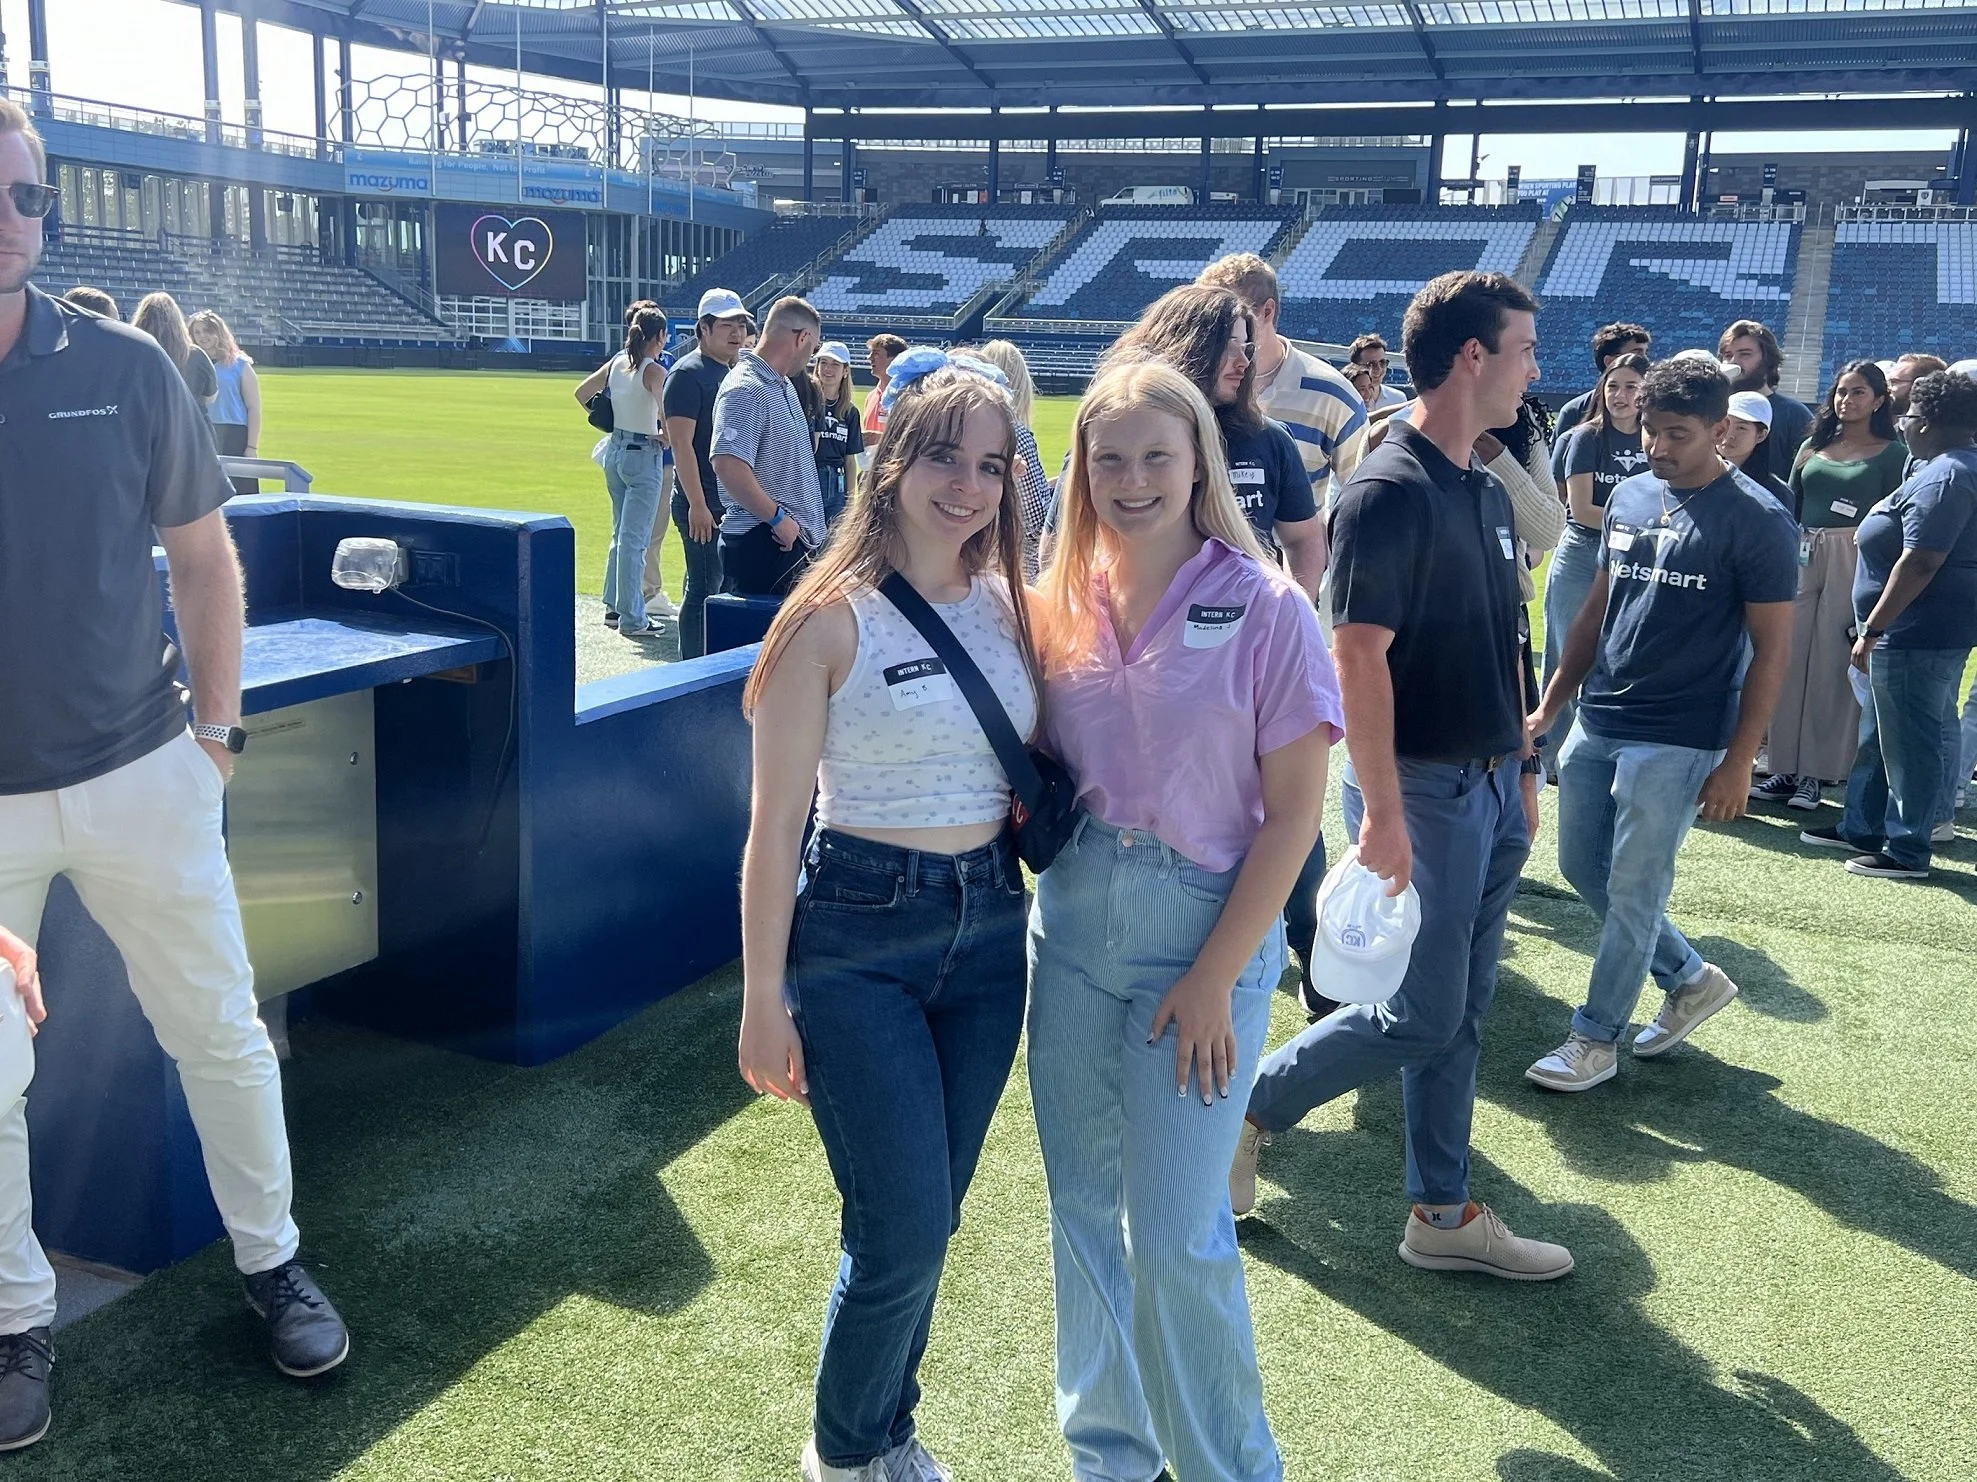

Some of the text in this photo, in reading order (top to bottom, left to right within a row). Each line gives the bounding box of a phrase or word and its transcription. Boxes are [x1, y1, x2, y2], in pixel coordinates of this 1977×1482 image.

[349, 173, 428, 191] mazuma
[524, 185, 601, 203] mazuma
[487, 231, 535, 270] KC
[48, 408, 107, 419] GRUNDFOS
[1610, 559, 1708, 591] Netsmart
[1201, 610, 1223, 618] INTERN
[897, 663, 931, 676] INTERN KC
